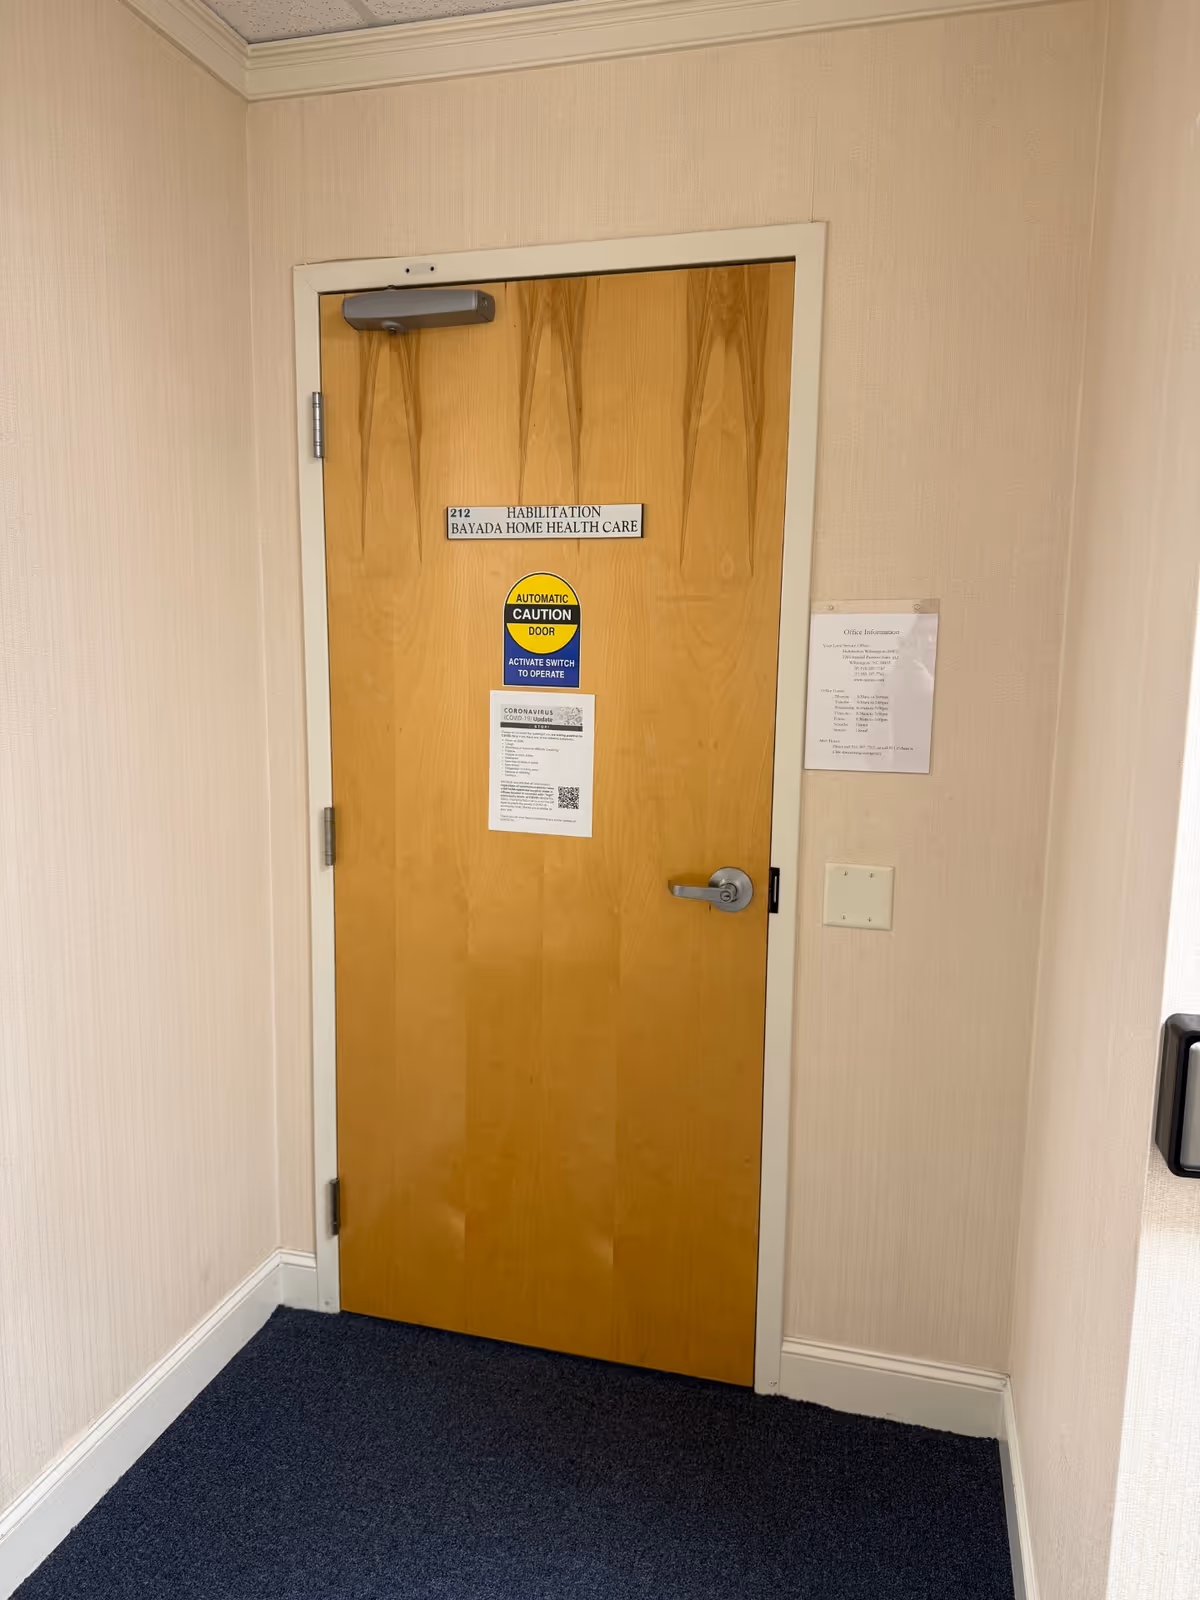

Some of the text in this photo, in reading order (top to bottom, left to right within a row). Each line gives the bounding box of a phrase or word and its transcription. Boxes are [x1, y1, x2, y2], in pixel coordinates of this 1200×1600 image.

[450, 508, 471, 518] 212
[507, 506, 602, 518] HABILITATION
[450, 520, 639, 535] BAYADA HOME HEALTH CARE
[516, 593, 569, 604] AUTOMATIC
[512, 608, 572, 621] CAUTION
[528, 626, 555, 636] DOOR
[843, 628, 900, 636] Office Information
[508, 658, 575, 668] ACTIVATE SWITCH
[518, 669, 565, 679] TO OPERATE
[503, 707, 554, 716] CORONAVIRUS
